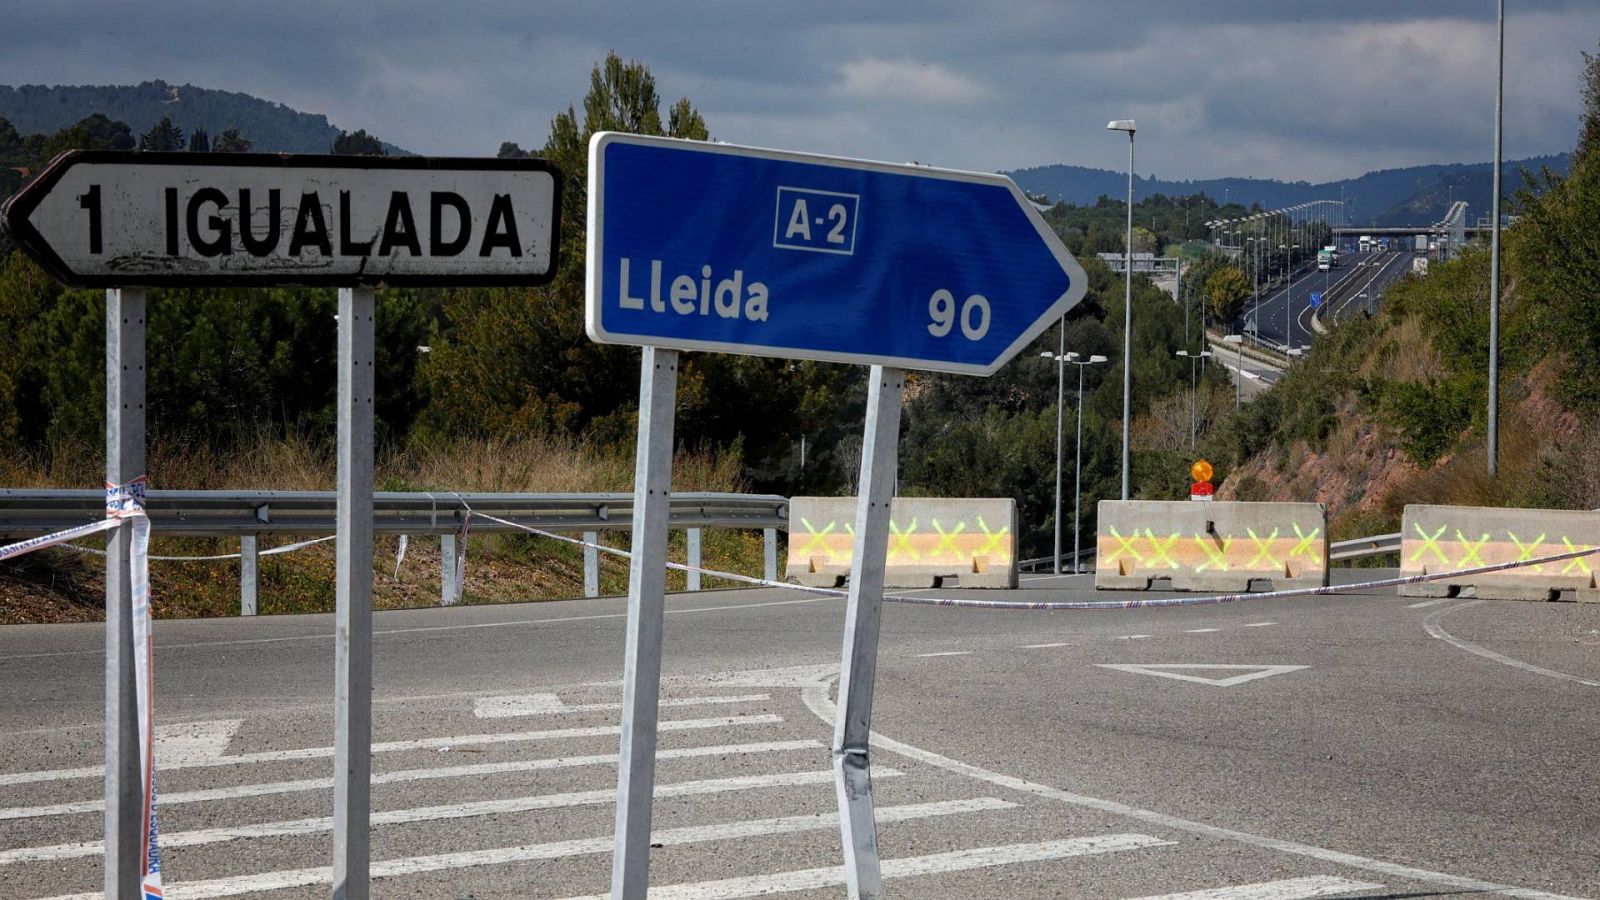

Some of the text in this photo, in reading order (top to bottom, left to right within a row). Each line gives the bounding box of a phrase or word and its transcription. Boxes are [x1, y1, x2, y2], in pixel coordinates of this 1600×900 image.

[76, 184, 523, 258] 1 IGUALADA
[785, 199, 848, 244] A-2
[619, 257, 992, 341] Lleida 90
